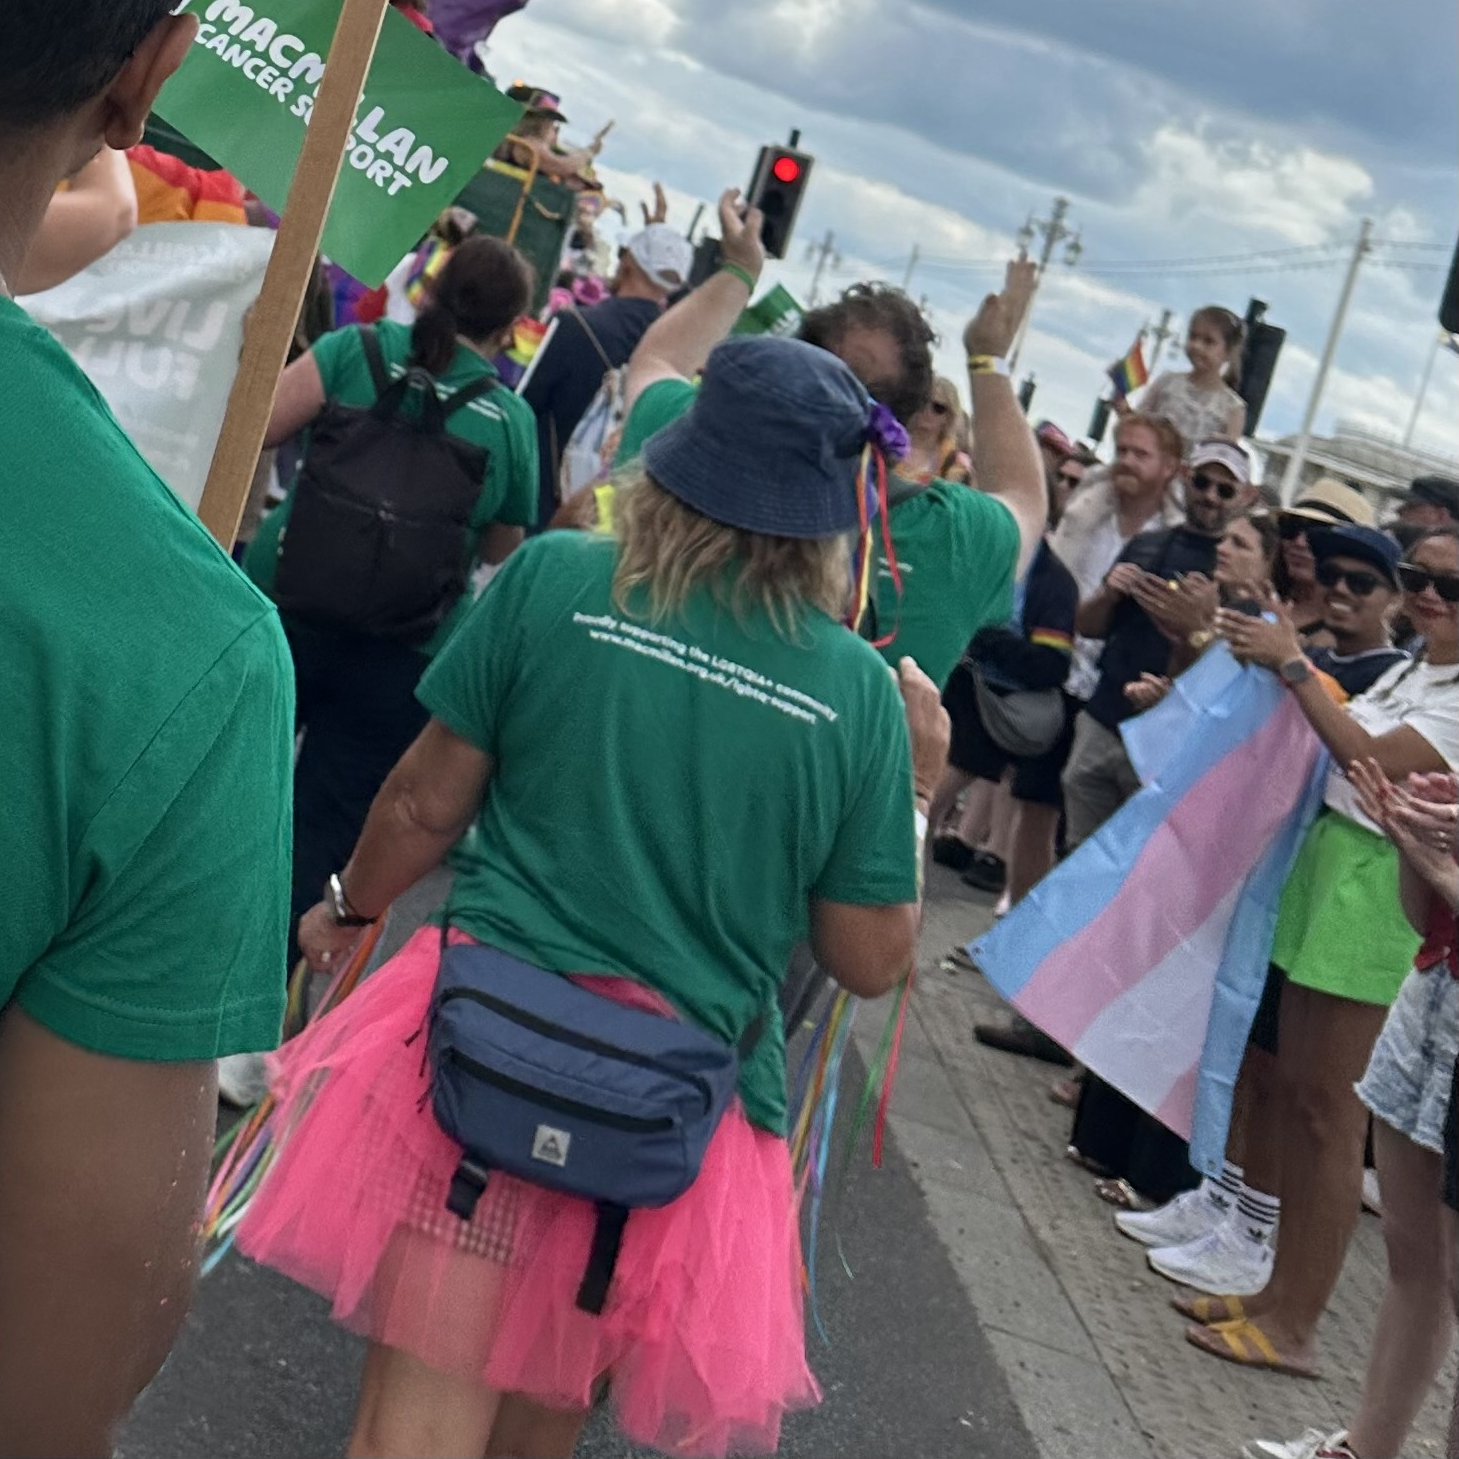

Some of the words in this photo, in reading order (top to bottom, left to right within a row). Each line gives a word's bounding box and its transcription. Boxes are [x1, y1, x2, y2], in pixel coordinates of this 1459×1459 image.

[193, 23, 294, 103] CANCER
[619, 621, 688, 655] supporting
[688, 645, 711, 664] the
[774, 682, 839, 723] community
